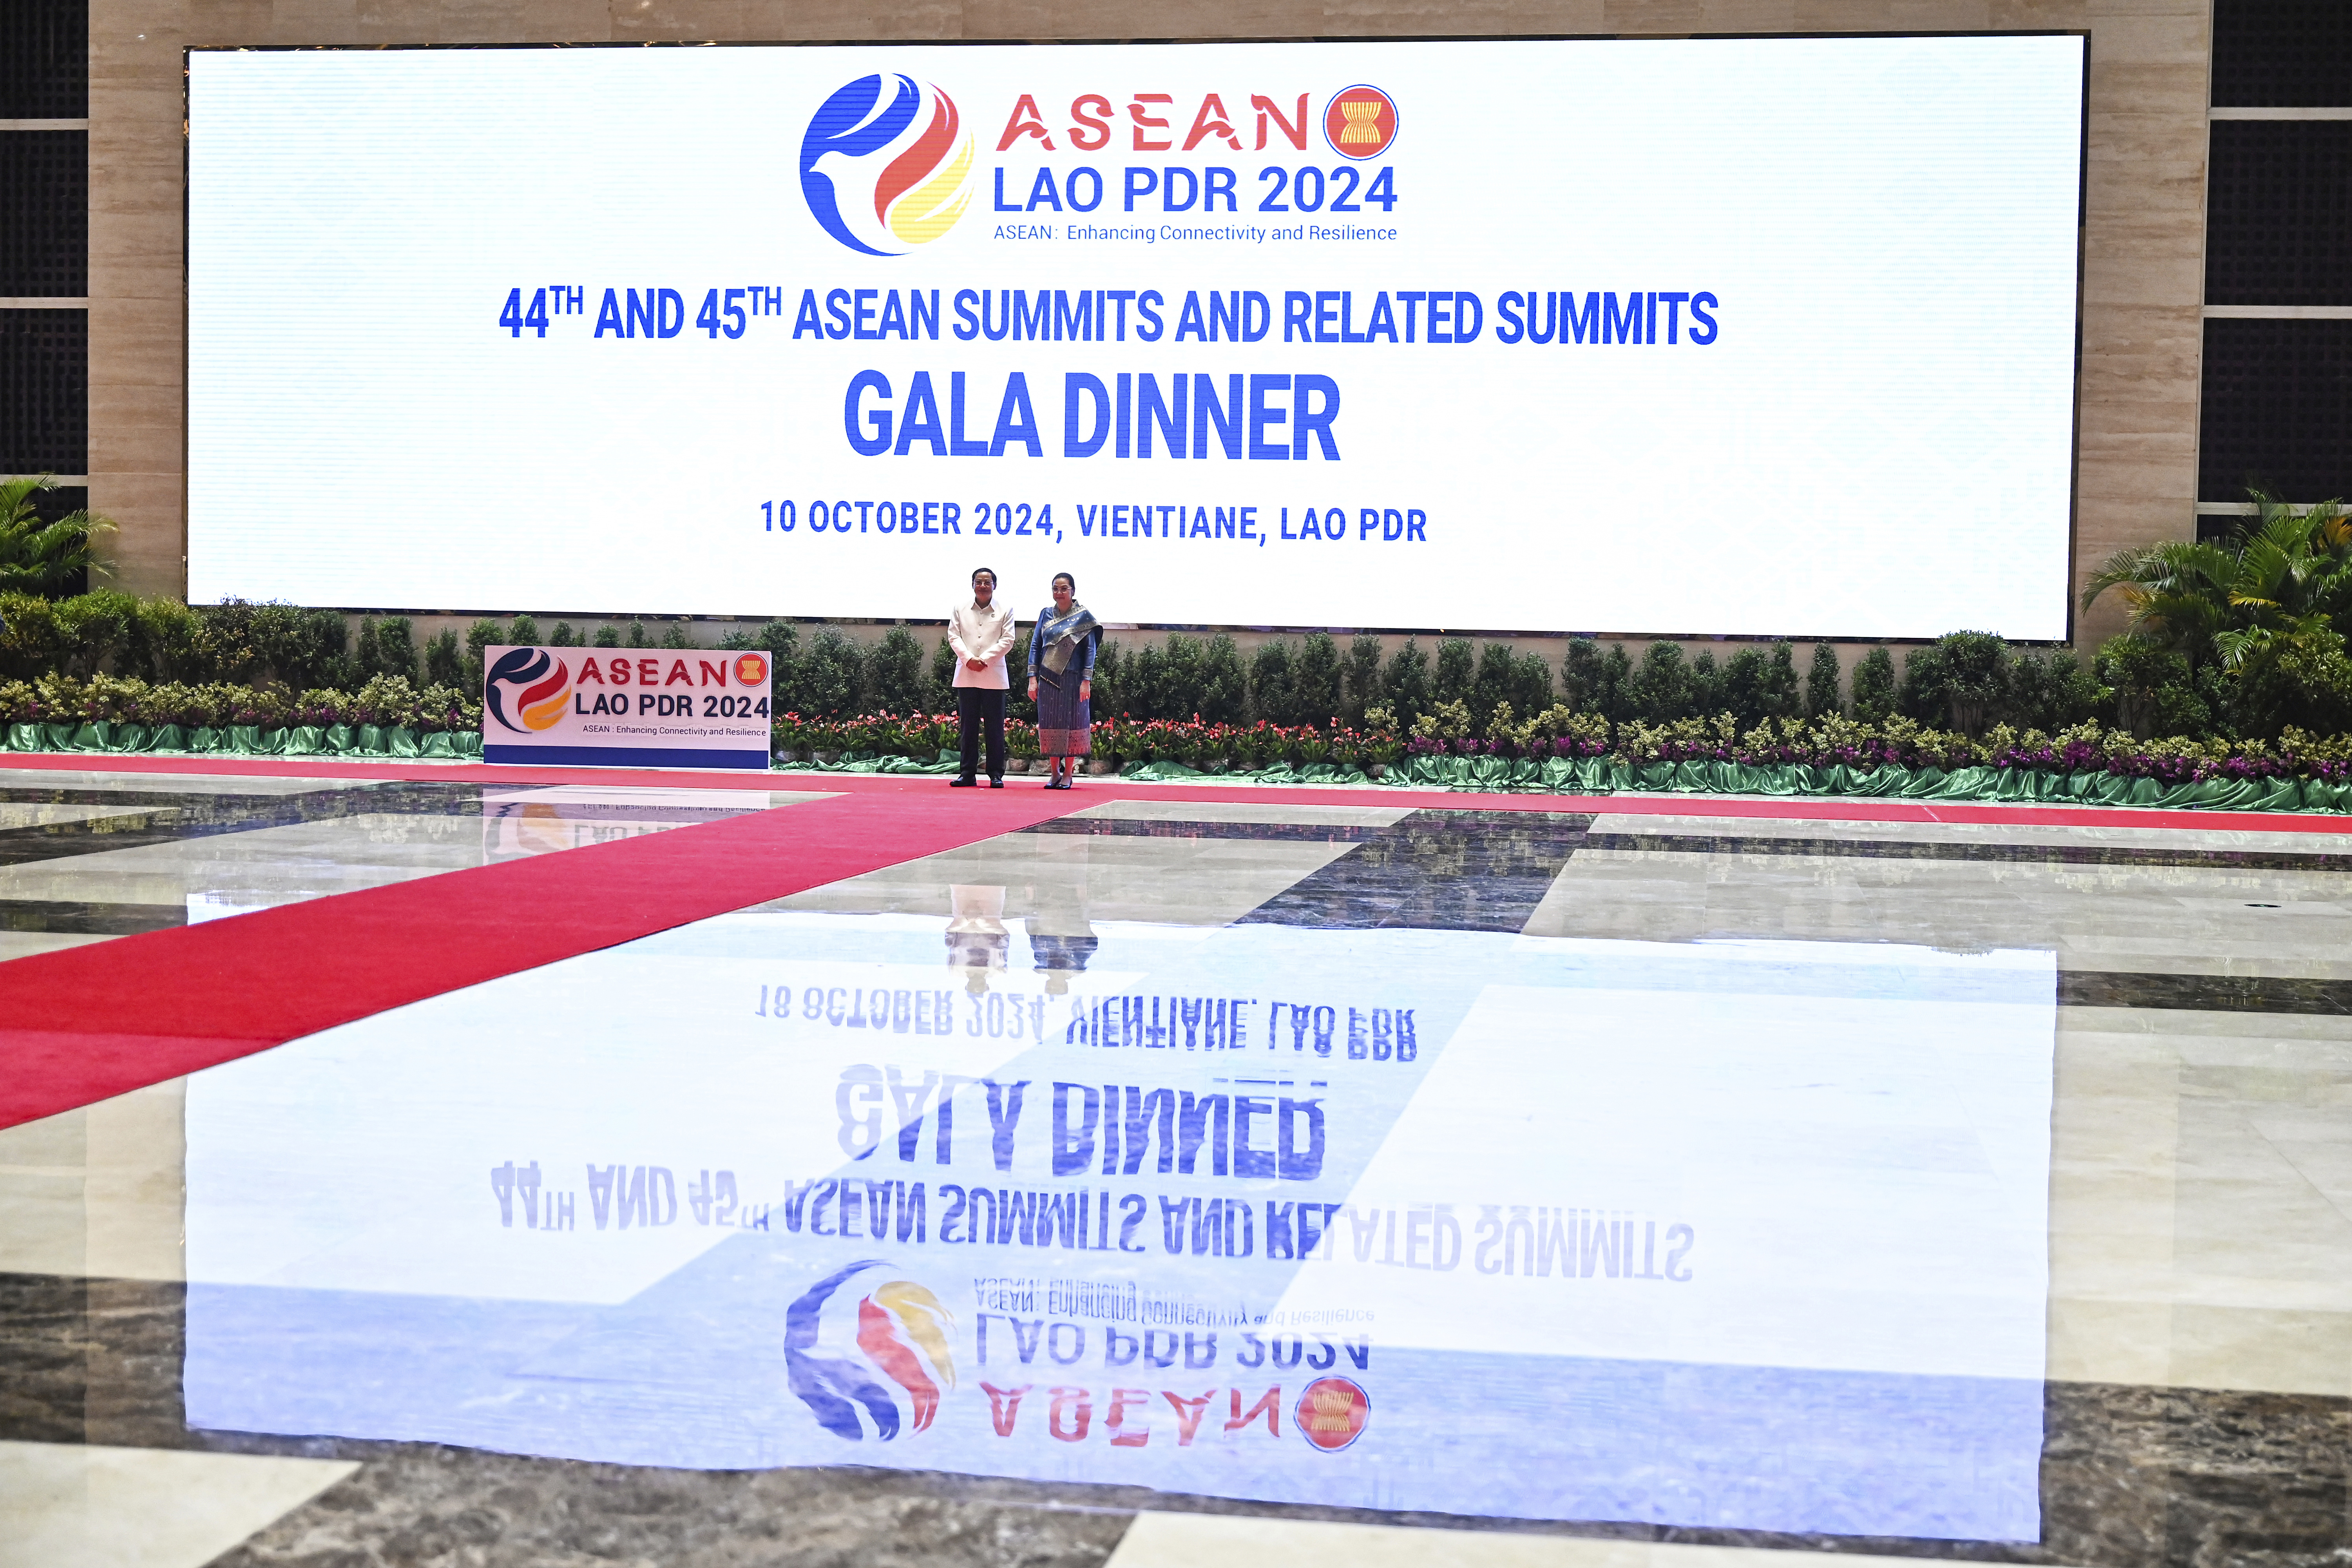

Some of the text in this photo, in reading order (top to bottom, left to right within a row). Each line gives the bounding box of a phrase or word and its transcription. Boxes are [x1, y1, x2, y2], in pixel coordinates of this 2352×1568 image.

[996, 93, 1309, 151] ASEAN
[994, 167, 1398, 212] LAO PDR 2024
[994, 225, 1397, 243] ASEAN: Enhancing Connectivity and Resilience
[499, 286, 1718, 345] 44TH AND 45TH ASEAN SUMMITS AND RELATED SUMMITS
[845, 369, 1341, 461] GALA DINNER
[761, 500, 1426, 547] 10 OCTOBER 2024, VIENTIANE, LAO PDR
[577, 657, 727, 687] ASEAN
[576, 693, 769, 718] LAO PDR 2024
[617, 726, 657, 735] Enhancing
[659, 727, 707, 736] Connectivity
